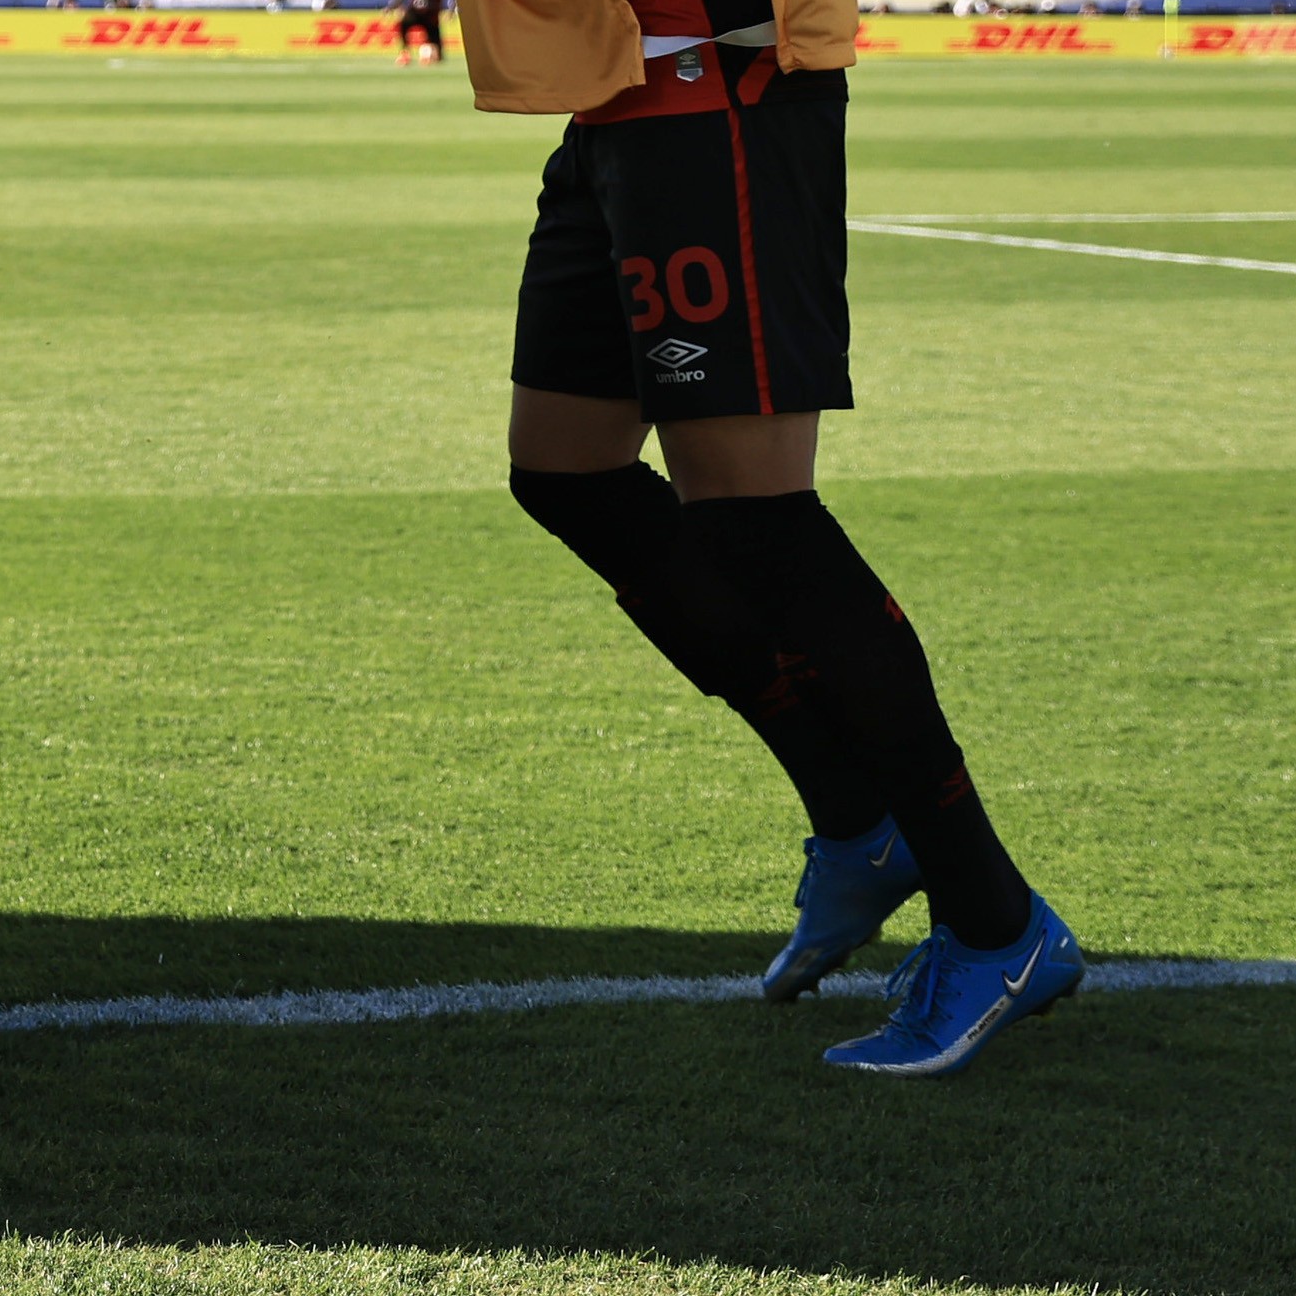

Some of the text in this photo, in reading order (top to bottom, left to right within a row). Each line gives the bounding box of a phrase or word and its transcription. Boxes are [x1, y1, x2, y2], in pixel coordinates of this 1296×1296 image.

[88, 17, 210, 46] DHL
[972, 24, 1086, 51] DHL
[621, 245, 729, 332] 30
[656, 369, 705, 383] umbro
